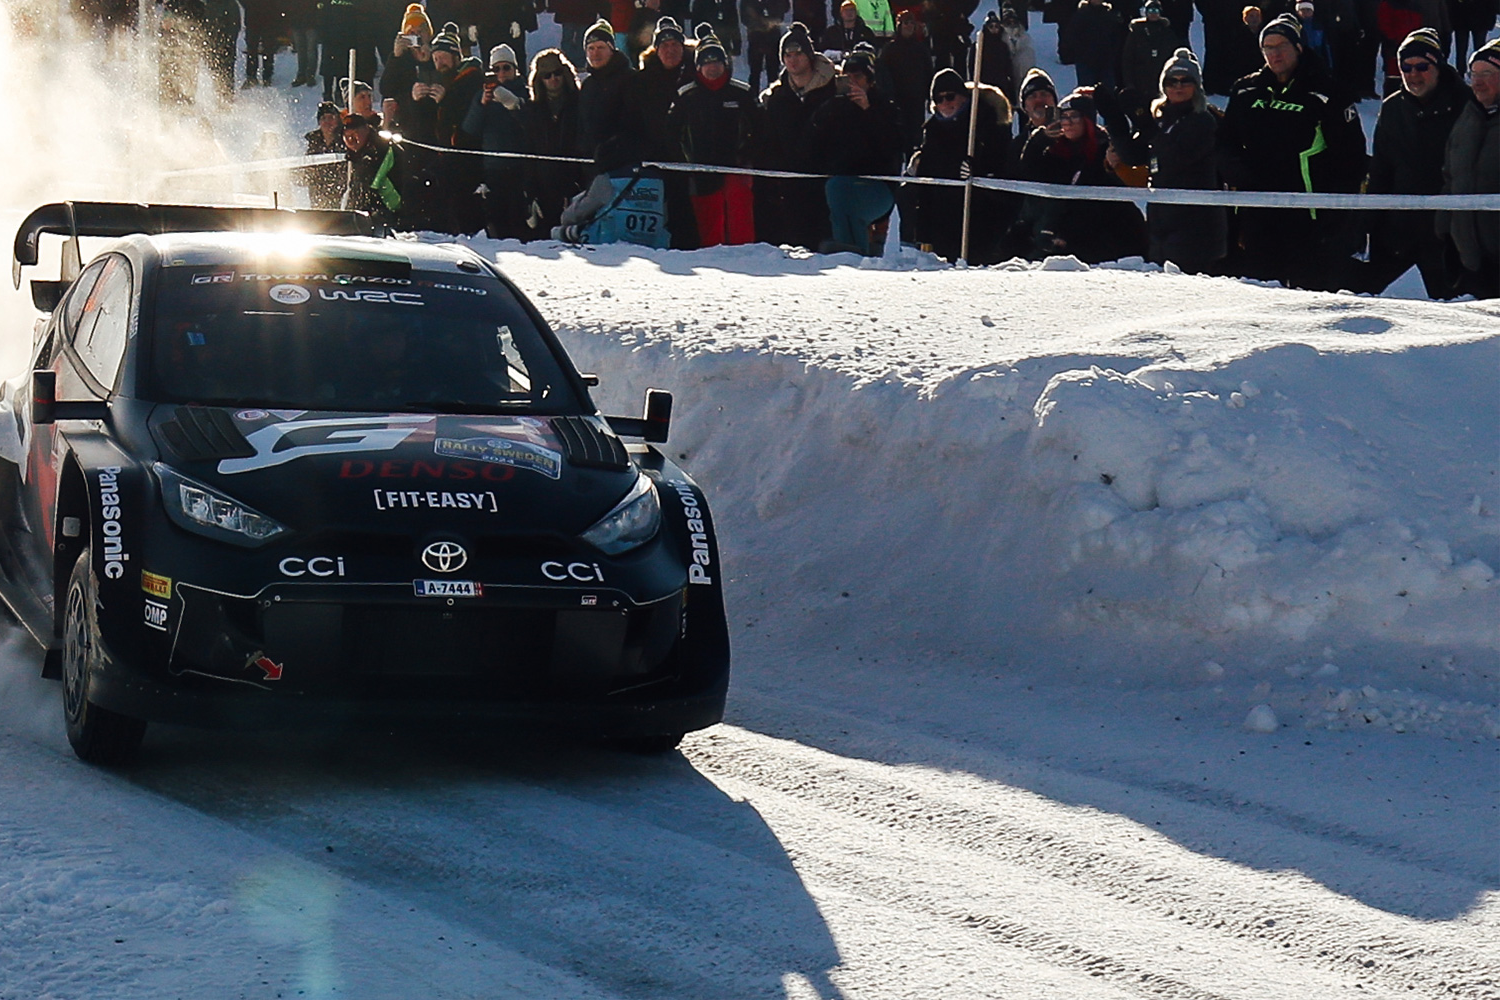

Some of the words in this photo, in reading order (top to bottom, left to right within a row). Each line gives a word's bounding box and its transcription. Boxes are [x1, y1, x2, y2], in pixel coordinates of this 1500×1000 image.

[626, 214, 657, 232] 012
[239, 272, 328, 282] TOYOTA
[330, 273, 412, 286] GAZOO
[318, 288, 425, 306] WRC
[442, 440, 488, 454] RALLY
[493, 448, 554, 469] SWEDEN
[481, 454, 515, 465] 2024
[338, 459, 517, 482] DENSO
[97, 465, 129, 580] Panasonic
[428, 582, 471, 594] A-7444
[144, 604, 168, 626] OMP
